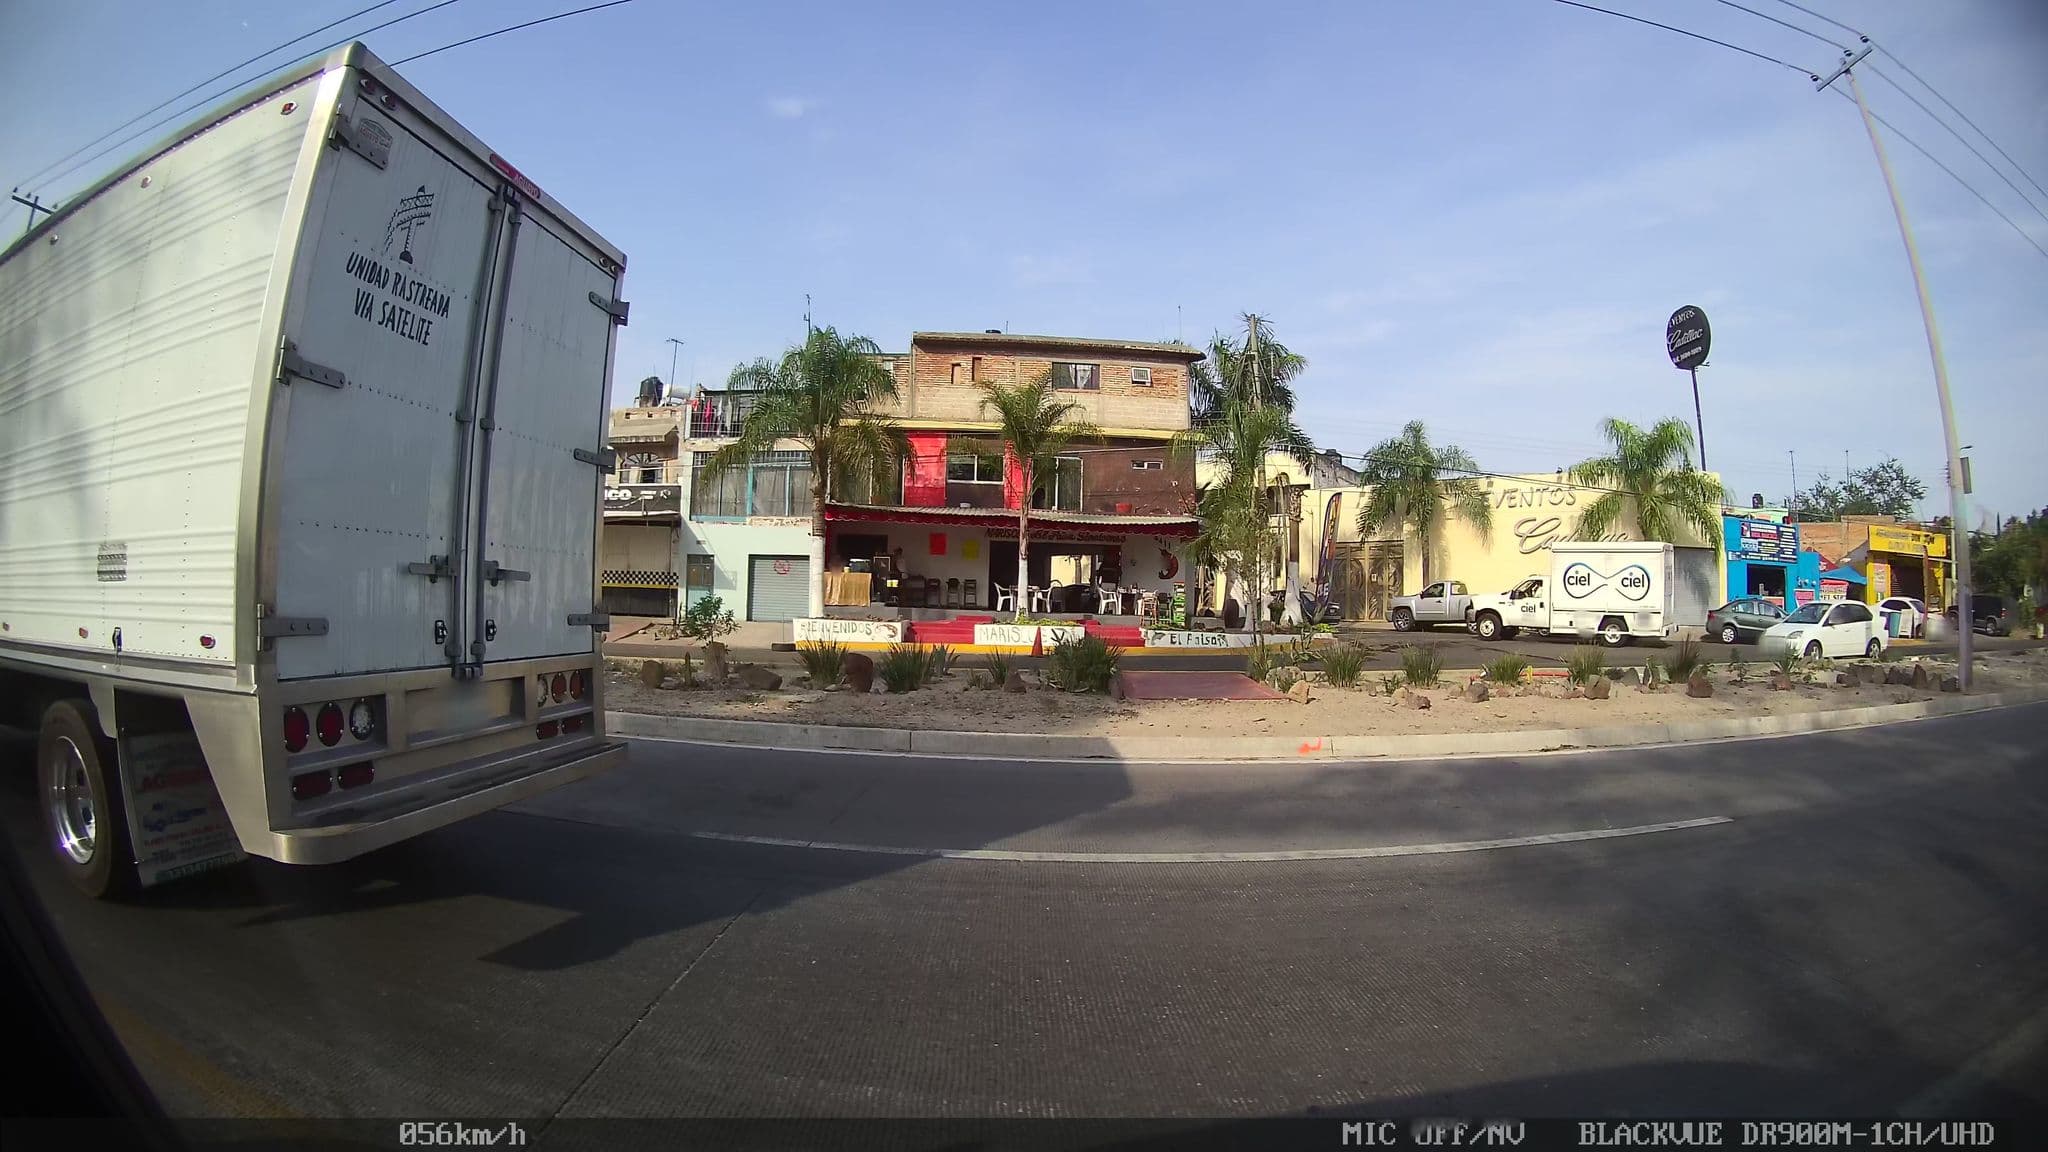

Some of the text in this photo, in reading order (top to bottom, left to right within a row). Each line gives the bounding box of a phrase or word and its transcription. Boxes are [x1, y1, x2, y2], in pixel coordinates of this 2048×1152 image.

[346, 251, 450, 319] UNIDAD RASTREADA
[354, 287, 433, 346] VIA SATELITE
[1667, 328, 1704, 352] Cadillac
[1567, 570, 1591, 587] ciel
[1621, 572, 1645, 589] ciel
[1520, 603, 1537, 613] ciel
